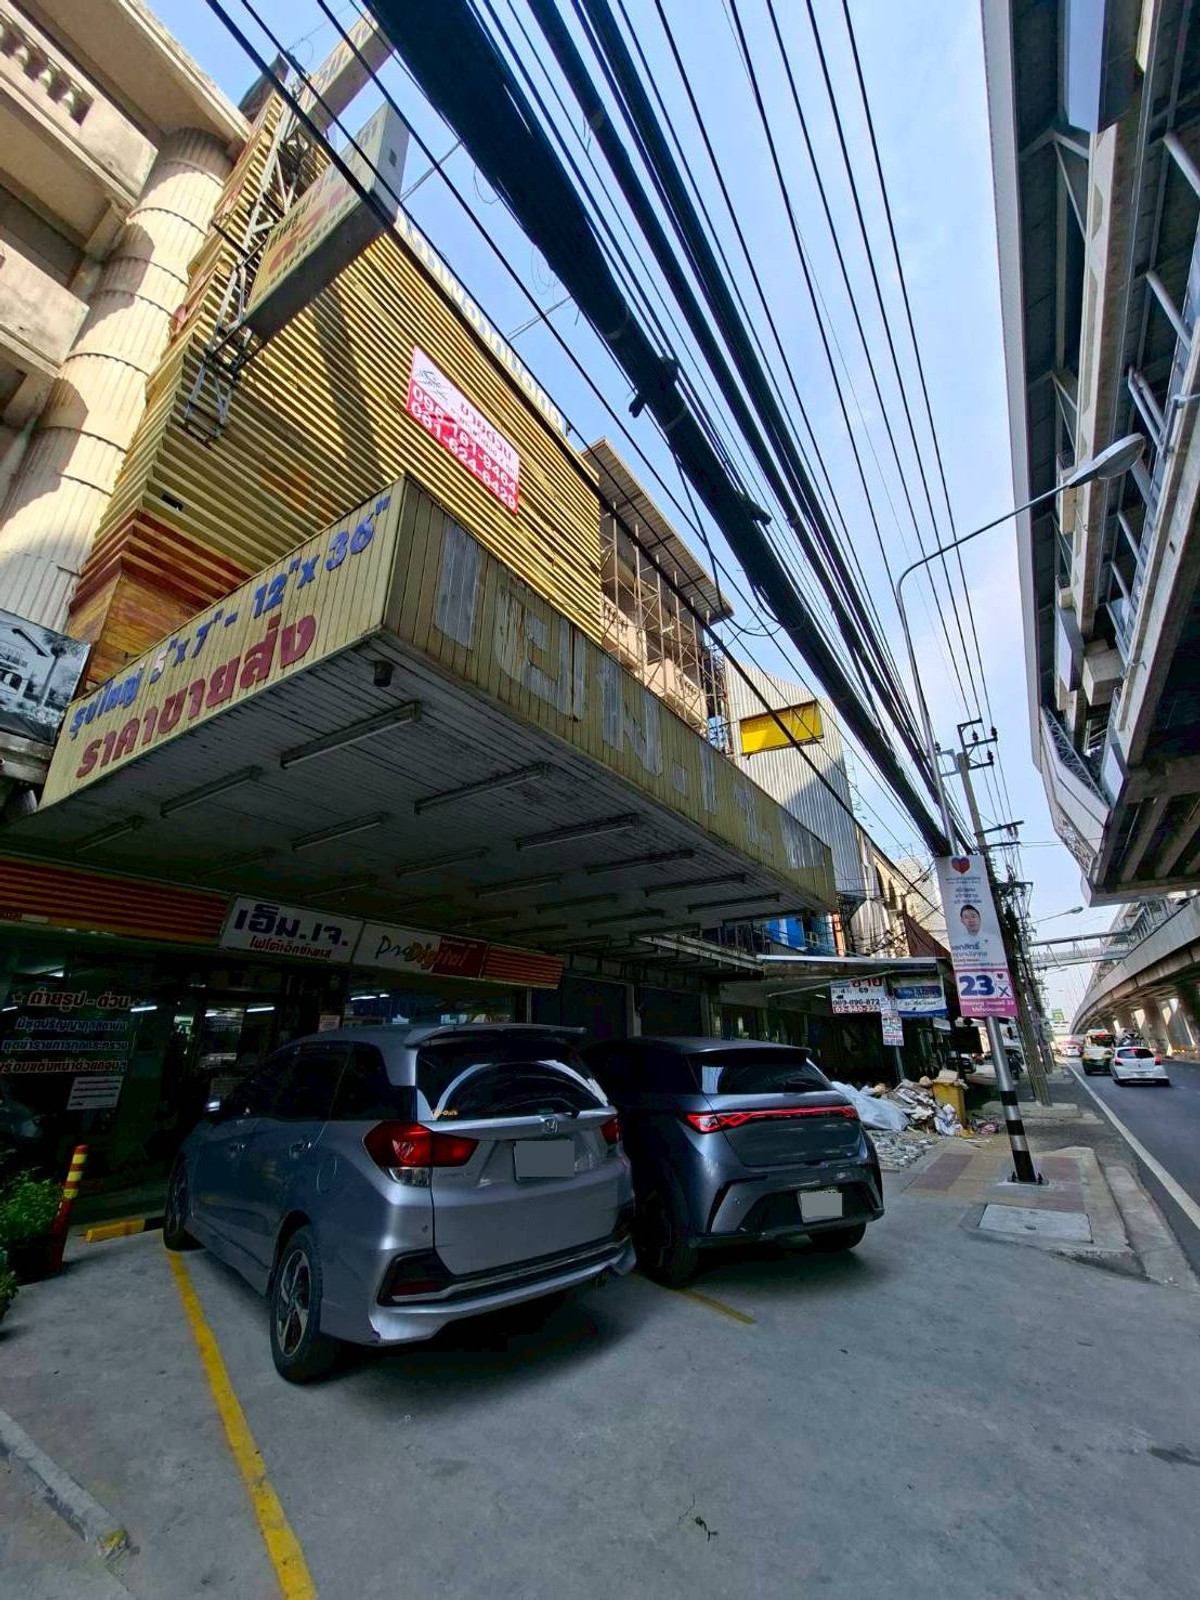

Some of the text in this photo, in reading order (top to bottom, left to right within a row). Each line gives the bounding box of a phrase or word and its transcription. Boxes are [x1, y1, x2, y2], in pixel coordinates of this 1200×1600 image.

[76, 613, 317, 779] ราคาขายส่ง
[958, 974, 995, 997] 23
